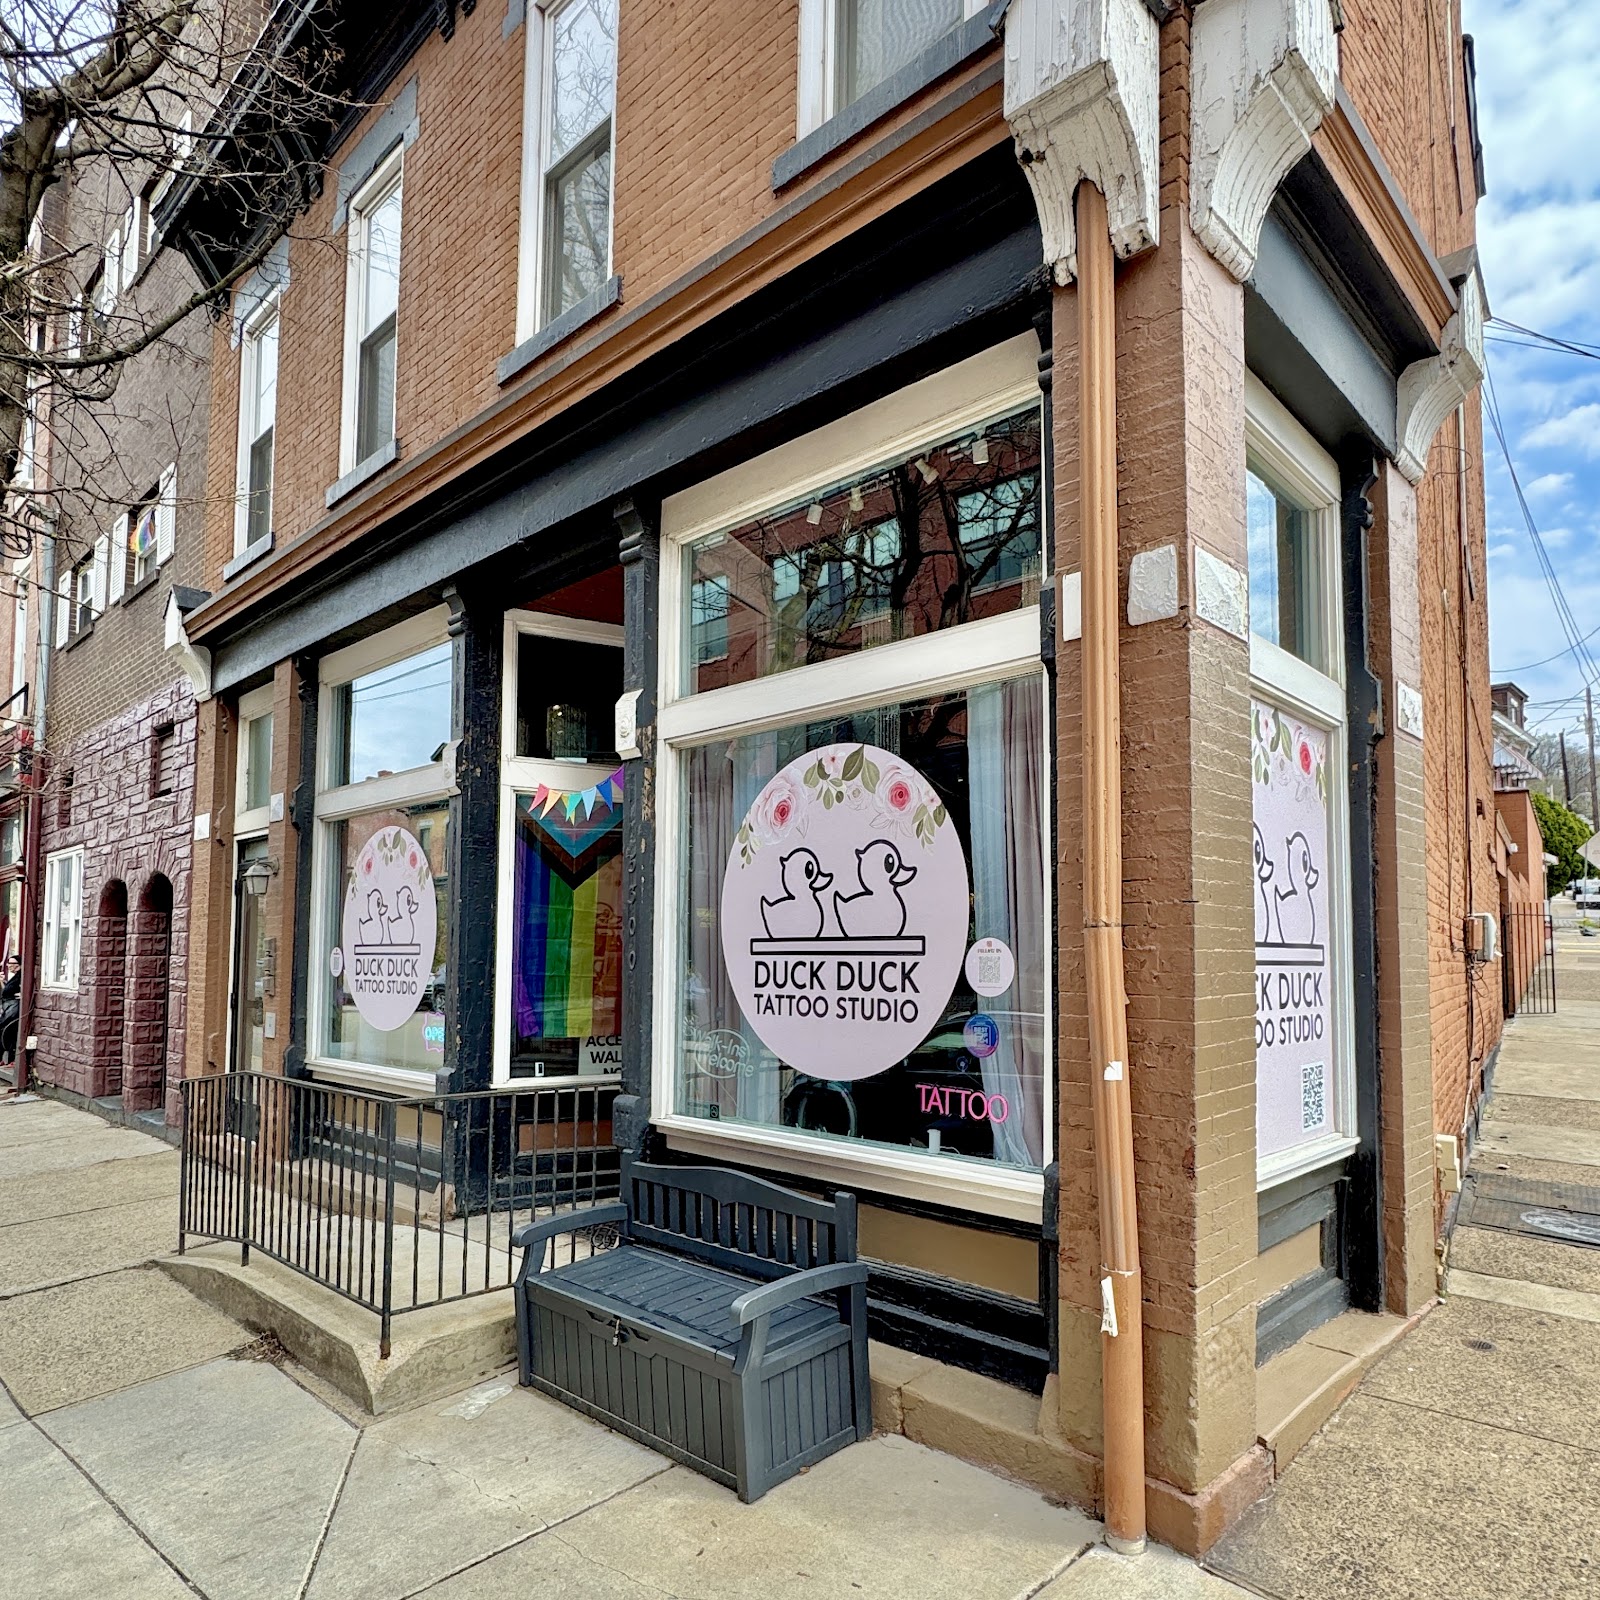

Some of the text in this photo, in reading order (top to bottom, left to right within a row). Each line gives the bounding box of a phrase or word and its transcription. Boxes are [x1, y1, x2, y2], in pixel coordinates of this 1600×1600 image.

[355, 958, 419, 977] DUCK DUCK
[754, 960, 920, 994] DUCK DUCK
[355, 979, 418, 995] TATTOO STUDIO
[1255, 972, 1323, 1011] K DUCK
[753, 993, 919, 1023] TATTOO STUDIO
[1279, 1013, 1323, 1045] STUDIO
[590, 1050, 622, 1064] WAL
[915, 1084, 1009, 1124] TATTOO
